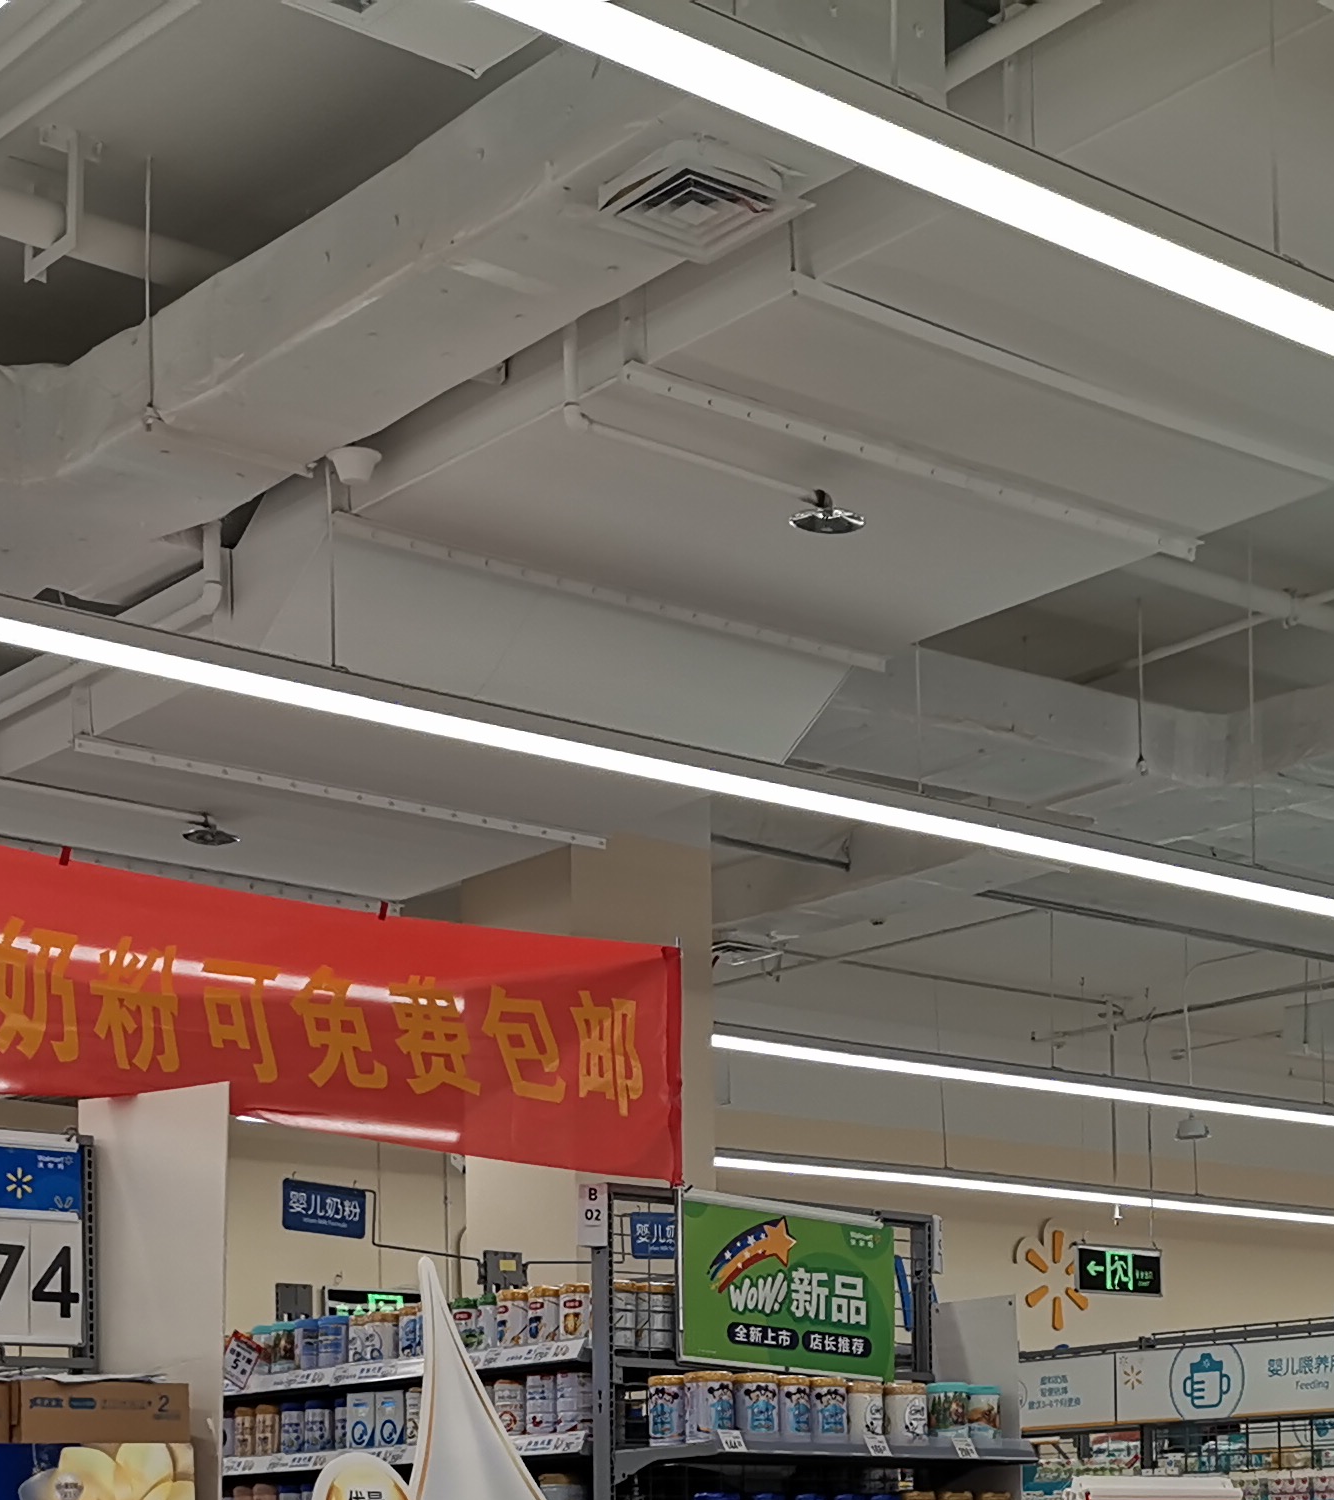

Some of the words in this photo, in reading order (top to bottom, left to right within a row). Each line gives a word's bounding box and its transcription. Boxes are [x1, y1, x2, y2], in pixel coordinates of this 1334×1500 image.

[589, 1187, 598, 1201] B
[289, 1191, 361, 1222] 婴儿奶粉
[584, 1209, 602, 1221] 02
[790, 1266, 868, 1327] 新品
[734, 1325, 793, 1347] 全新上市
[809, 1332, 865, 1354] 店长推荐
[1295, 1379, 1330, 1391] Feeding
